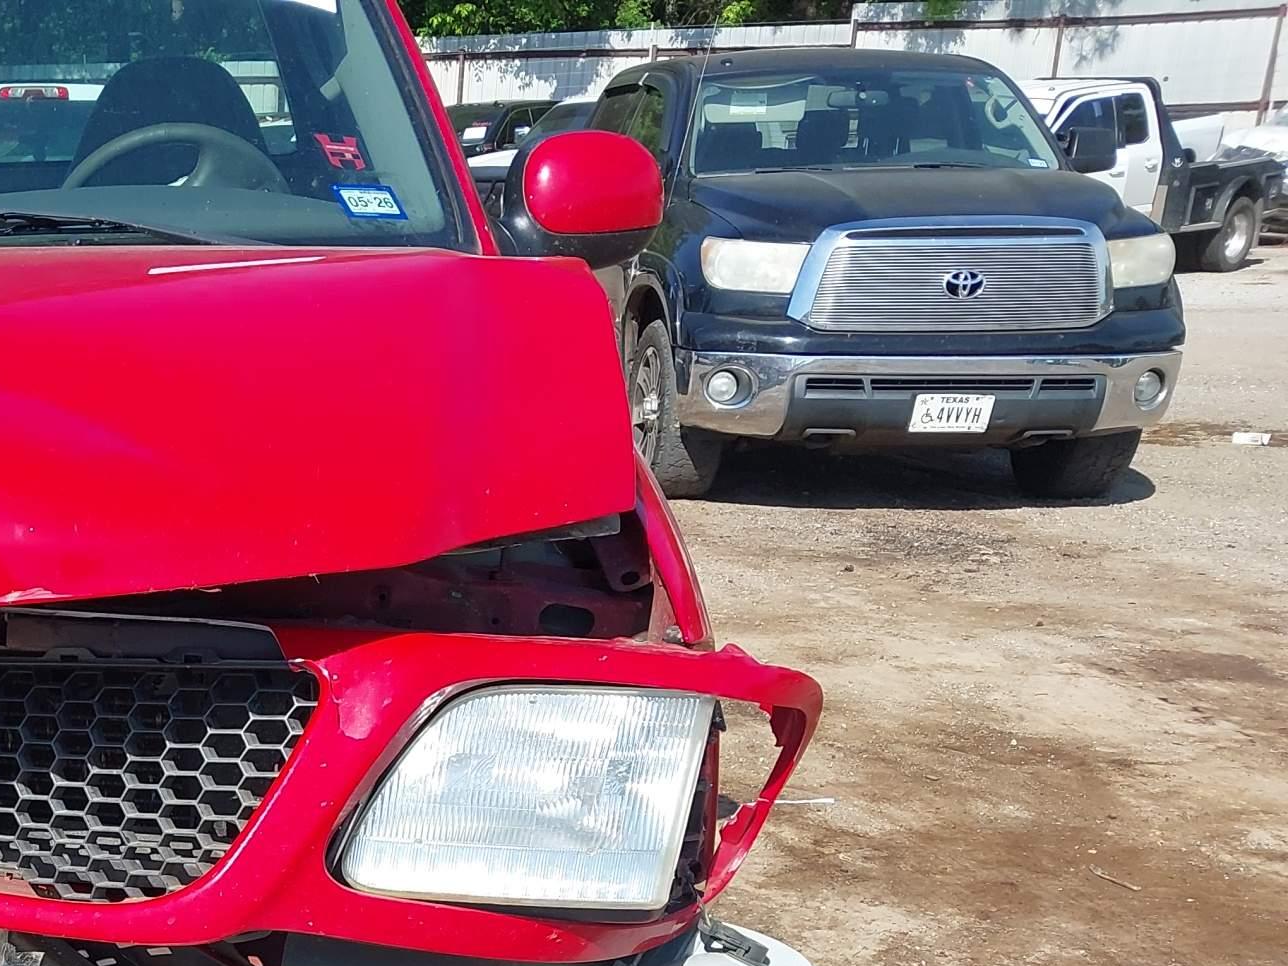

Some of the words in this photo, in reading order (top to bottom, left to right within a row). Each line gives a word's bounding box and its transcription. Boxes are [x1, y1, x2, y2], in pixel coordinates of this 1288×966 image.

[373, 196, 394, 209] 26
[940, 396, 970, 404] TEXAS
[936, 407, 983, 424] 4VVYH
